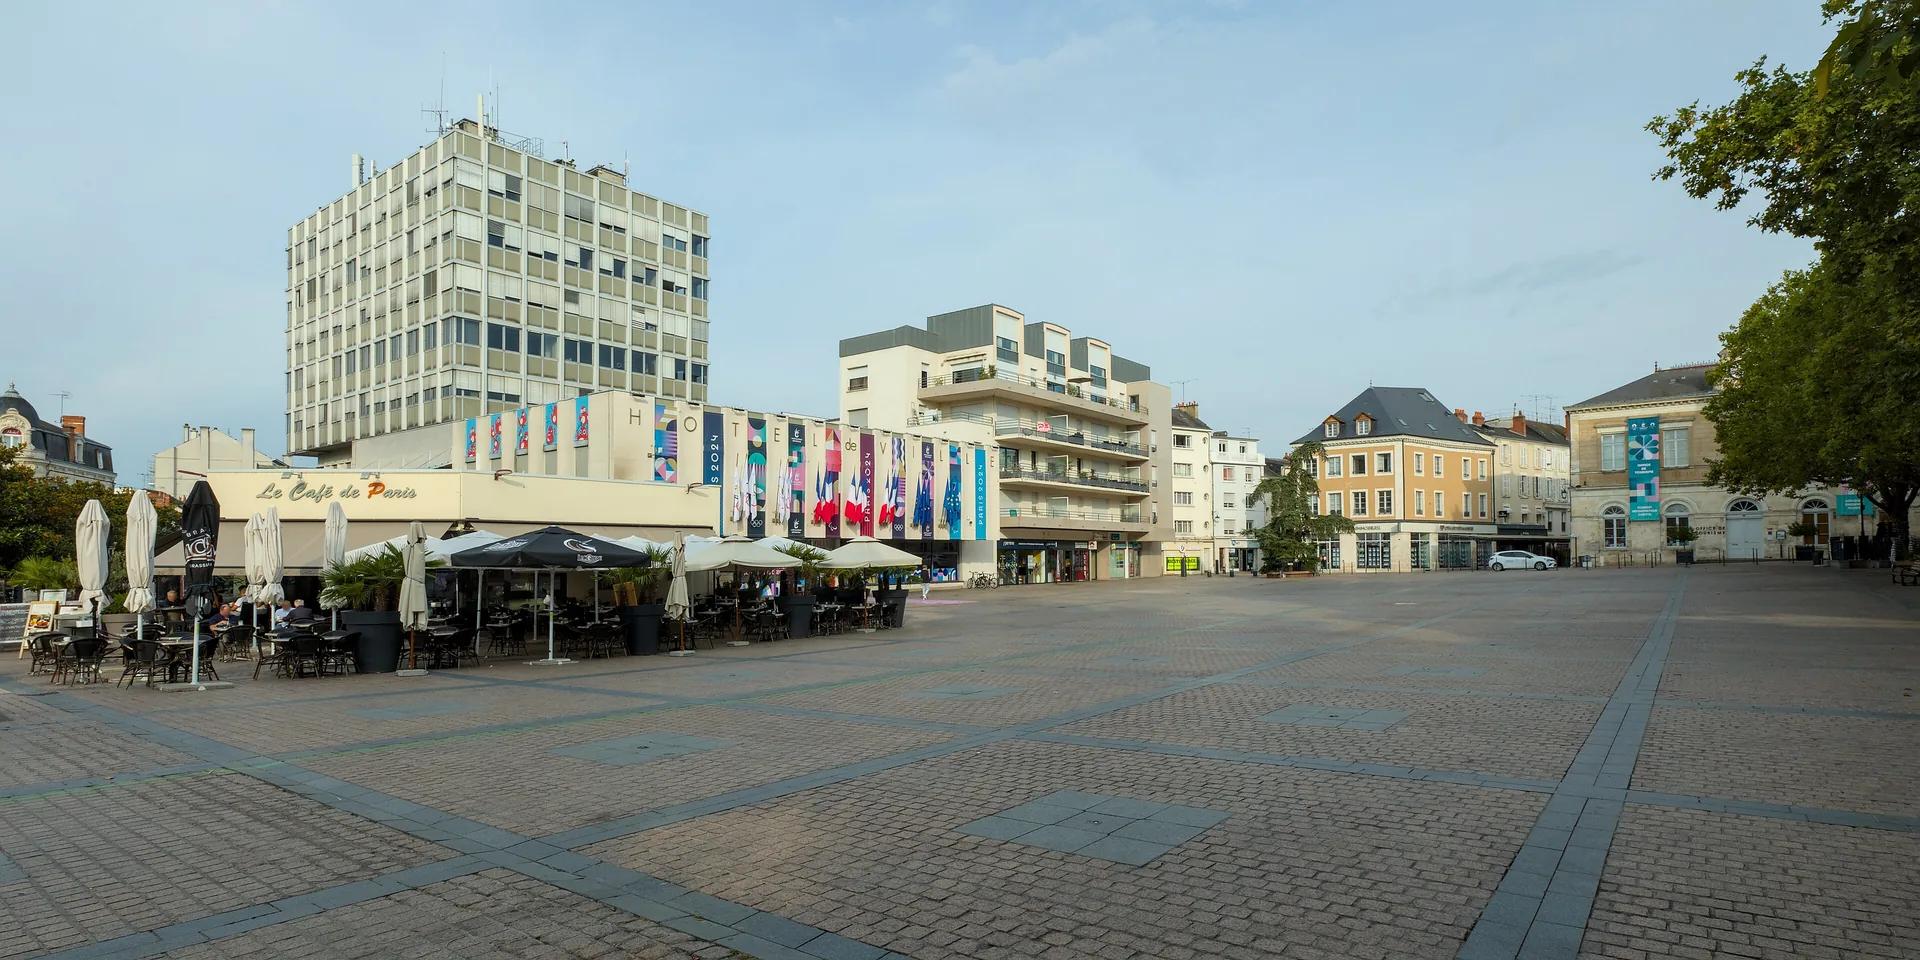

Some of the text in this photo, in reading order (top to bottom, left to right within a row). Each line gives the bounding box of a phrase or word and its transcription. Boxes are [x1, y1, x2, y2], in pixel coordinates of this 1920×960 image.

[710, 434, 719, 472] 2024
[844, 438, 857, 451] de
[880, 442, 995, 467] VILLE
[256, 480, 417, 503] Le Café de Paris
